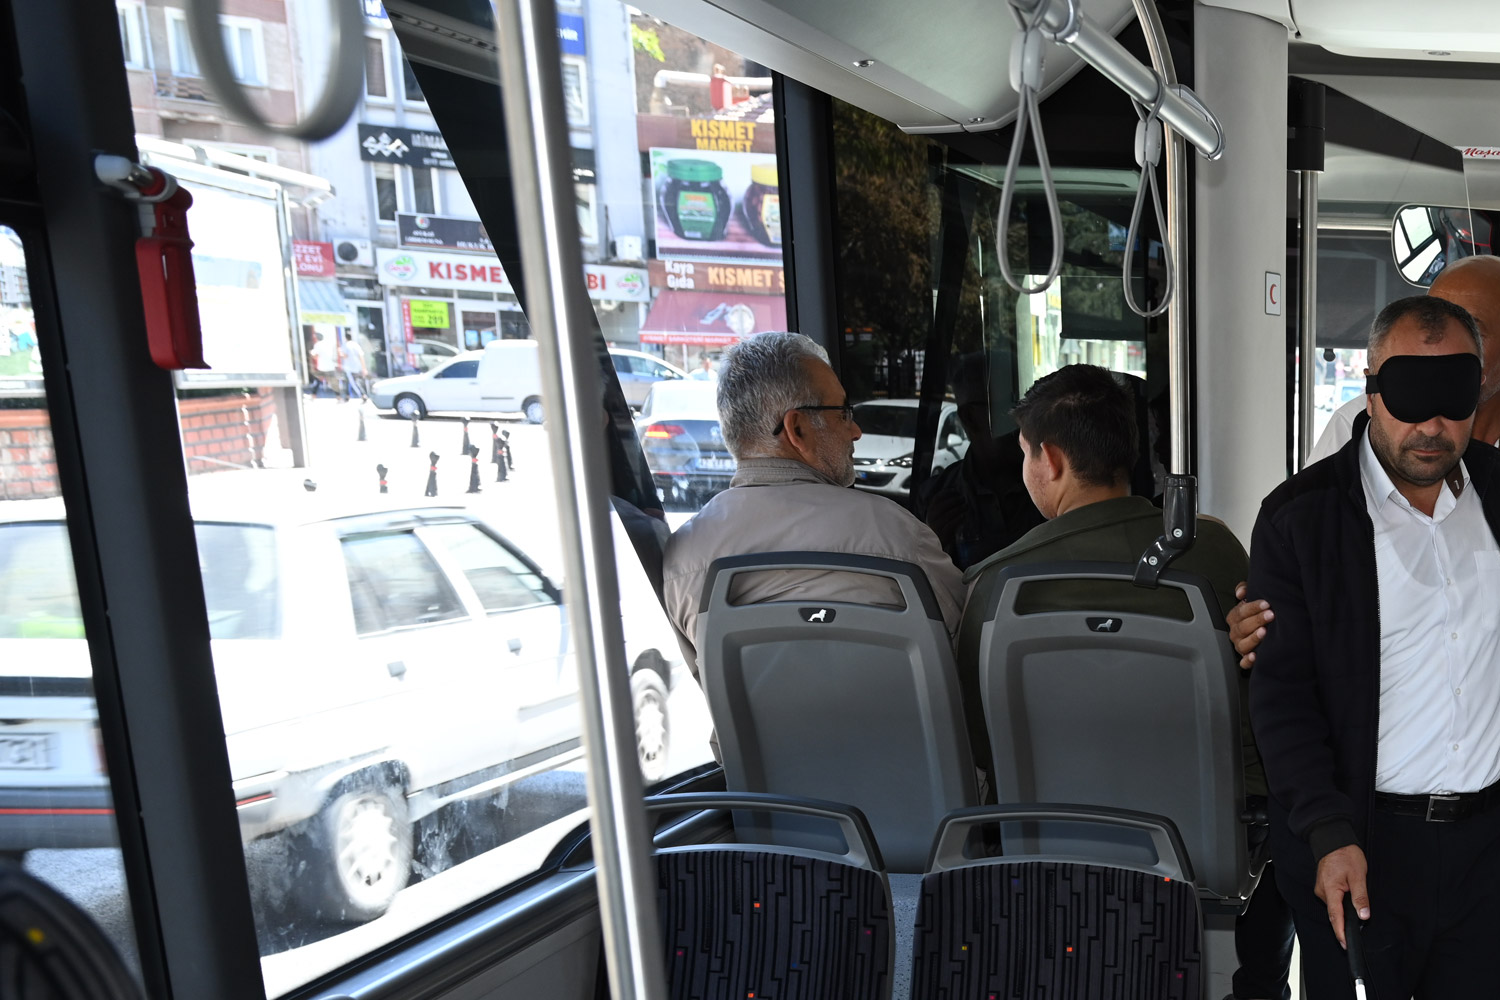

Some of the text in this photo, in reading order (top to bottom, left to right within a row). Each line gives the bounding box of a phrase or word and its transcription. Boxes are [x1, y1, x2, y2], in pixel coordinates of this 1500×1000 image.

[691, 119, 756, 140] KISMET
[696, 138, 753, 152] MARKET
[428, 261, 503, 283] KISME
[586, 273, 606, 291] BI
[665, 259, 694, 274] Kaya
[708, 266, 774, 288] KISMET
